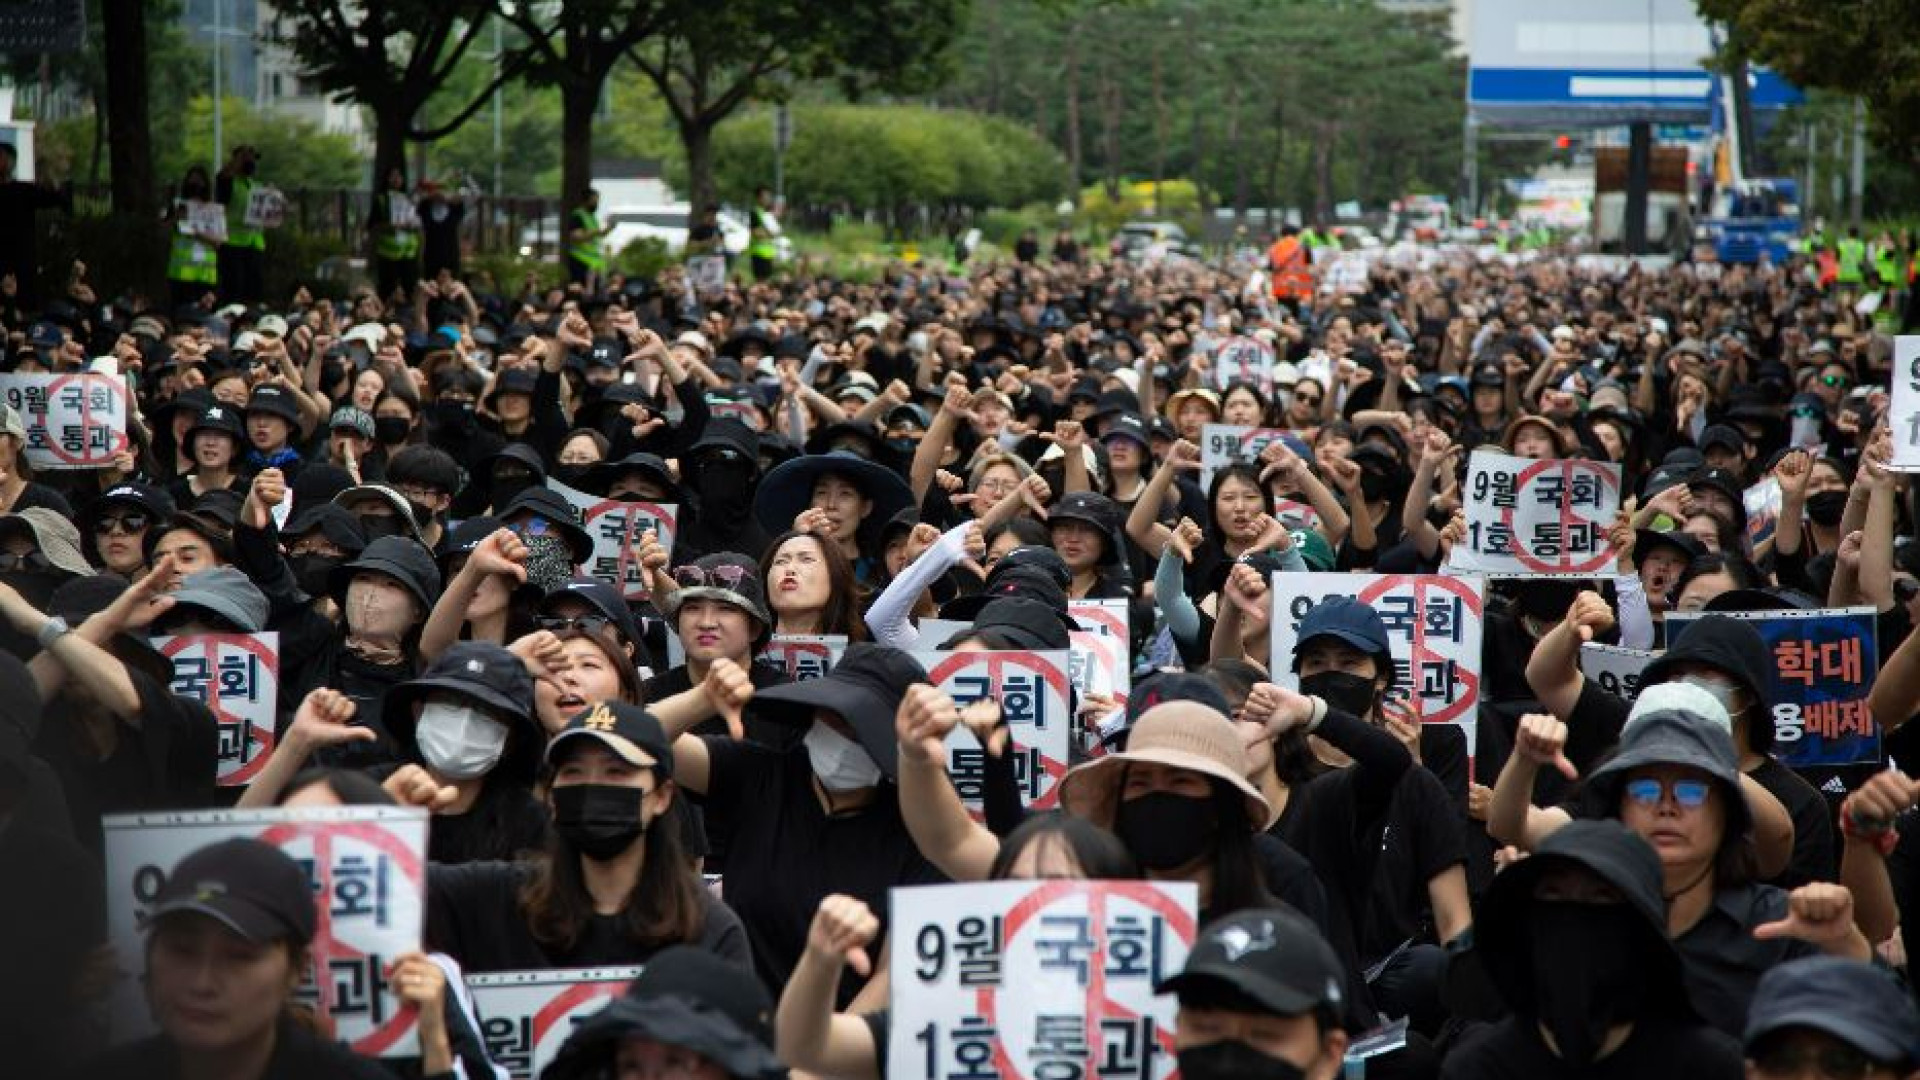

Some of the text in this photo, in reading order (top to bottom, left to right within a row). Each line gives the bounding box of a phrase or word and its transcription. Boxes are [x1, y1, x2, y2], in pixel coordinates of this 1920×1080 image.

[7, 386, 114, 414] 9월 국회
[26, 424, 113, 451] 호 통과
[1473, 470, 1603, 509] 9월 국회
[1469, 520, 1602, 557] 1호 통과
[1378, 596, 1463, 643] 국회
[174, 653, 258, 702] 국회
[1774, 637, 1862, 686] 학대
[217, 719, 254, 764] 과
[915, 914, 1166, 992] 9월 국회
[294, 953, 388, 1025] 과
[484, 1016, 533, 1080] 월
[915, 1014, 1160, 1080] 1호 통과
